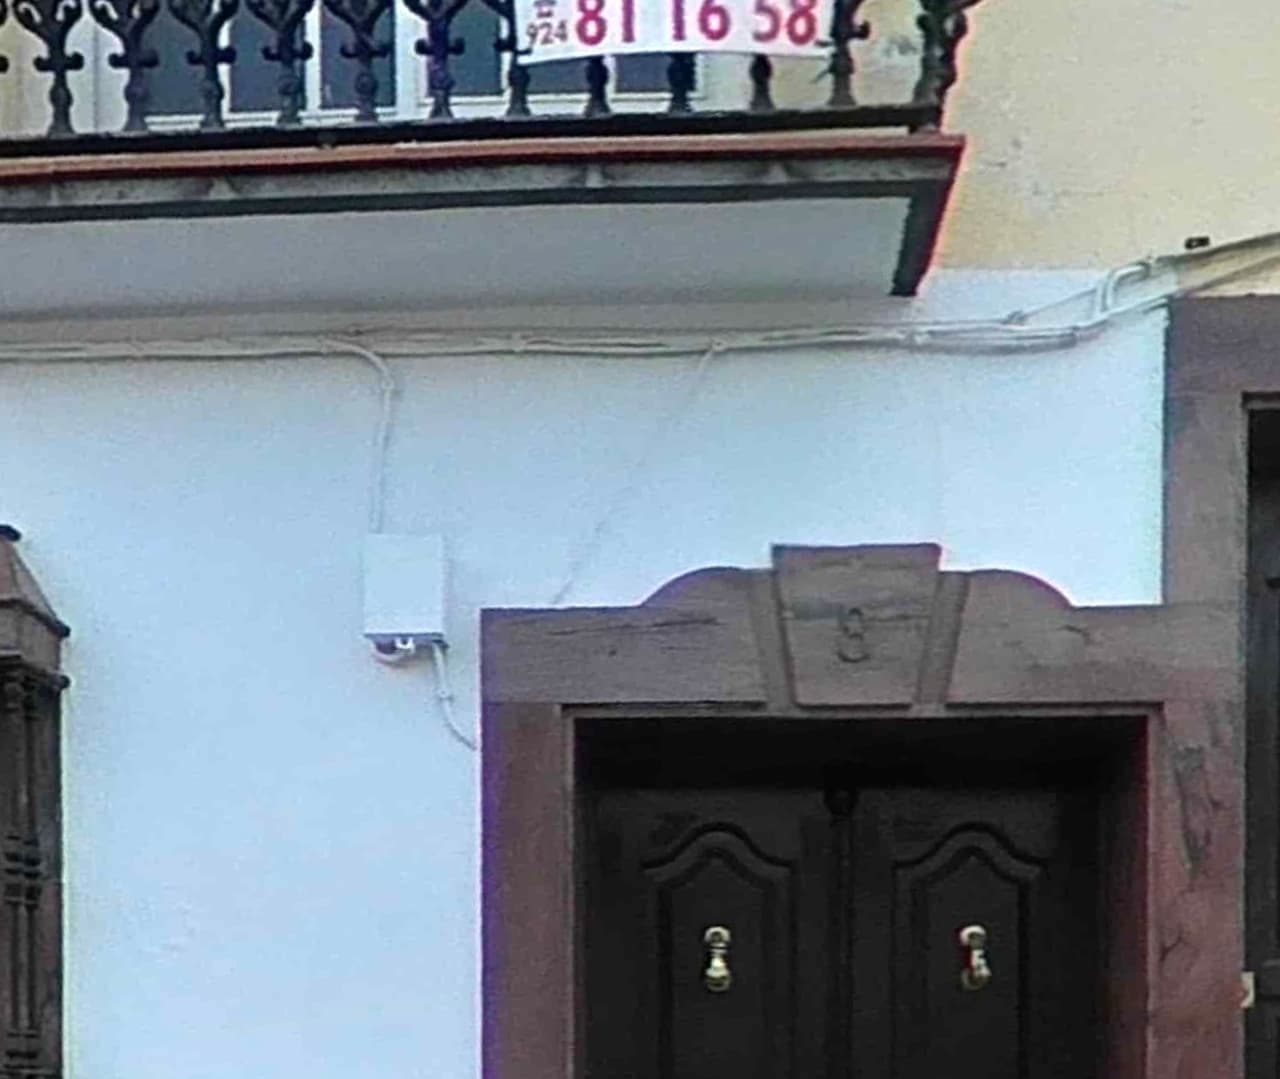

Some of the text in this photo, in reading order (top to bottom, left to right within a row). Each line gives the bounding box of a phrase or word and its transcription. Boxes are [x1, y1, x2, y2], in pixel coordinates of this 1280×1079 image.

[526, 0, 817, 46] 924 81 16 58
